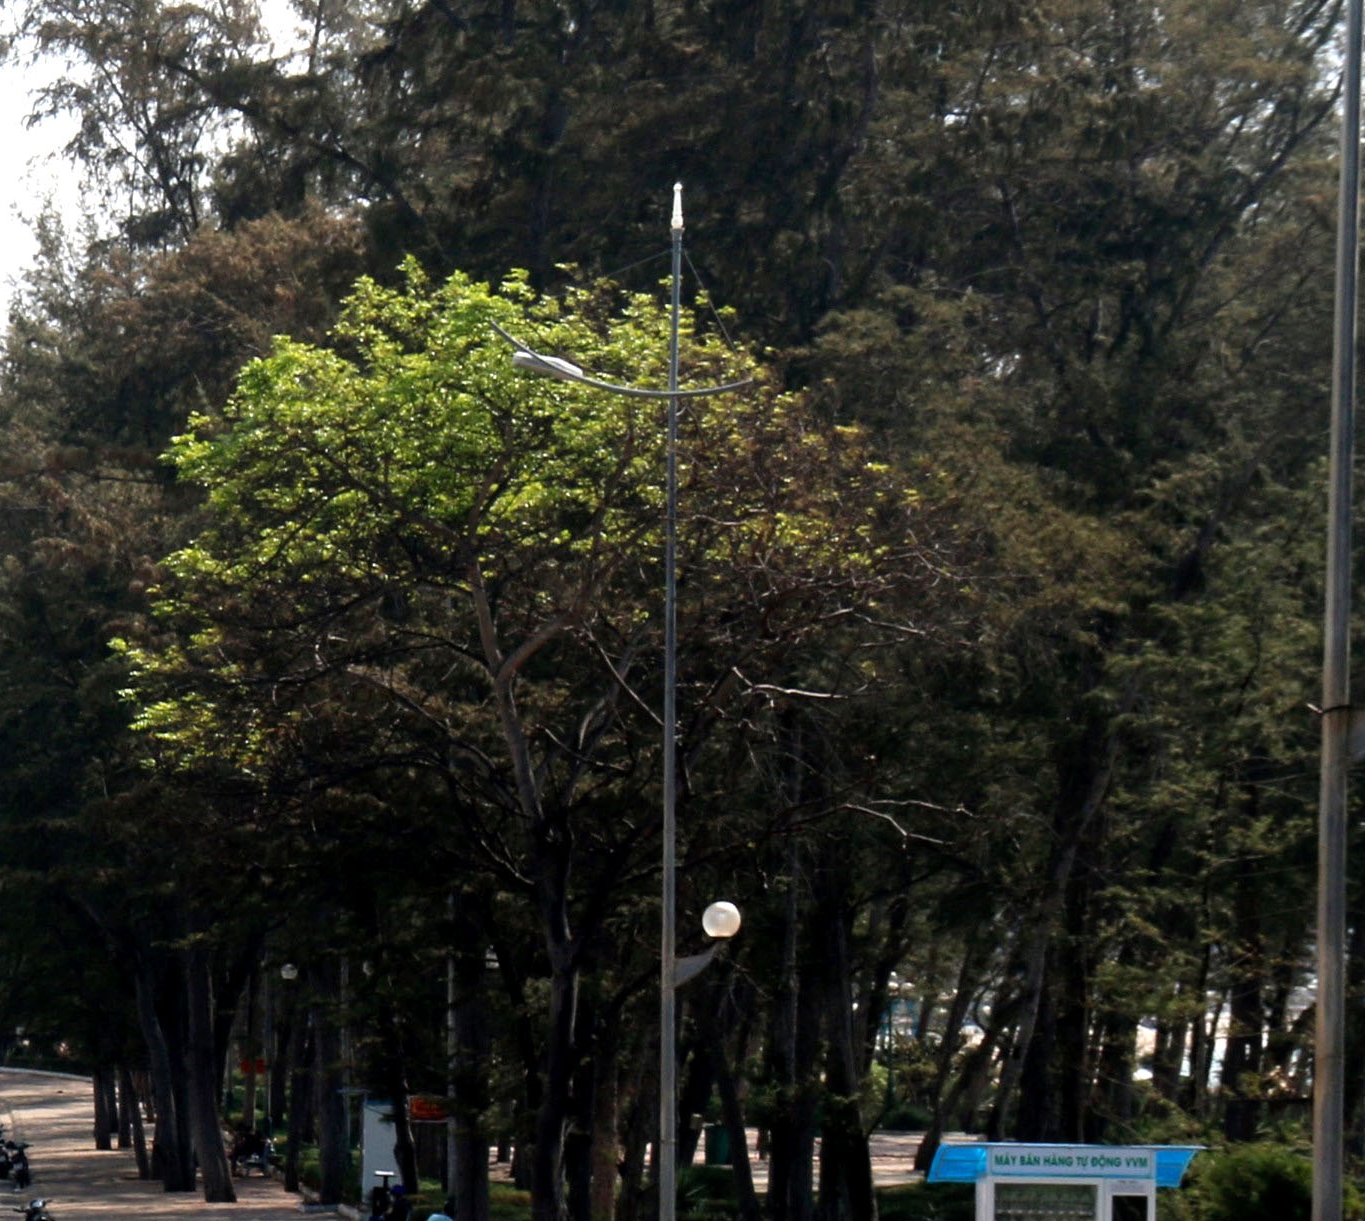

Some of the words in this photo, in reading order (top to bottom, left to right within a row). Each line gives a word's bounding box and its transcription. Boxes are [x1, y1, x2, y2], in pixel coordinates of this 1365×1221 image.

[994, 1151, 1017, 1166] MÁY
[1019, 1152, 1041, 1166] BÁN
[1043, 1152, 1073, 1167] HÀNG
[1090, 1154, 1122, 1169] ĐỘNG
[1124, 1156, 1149, 1168] VVM
